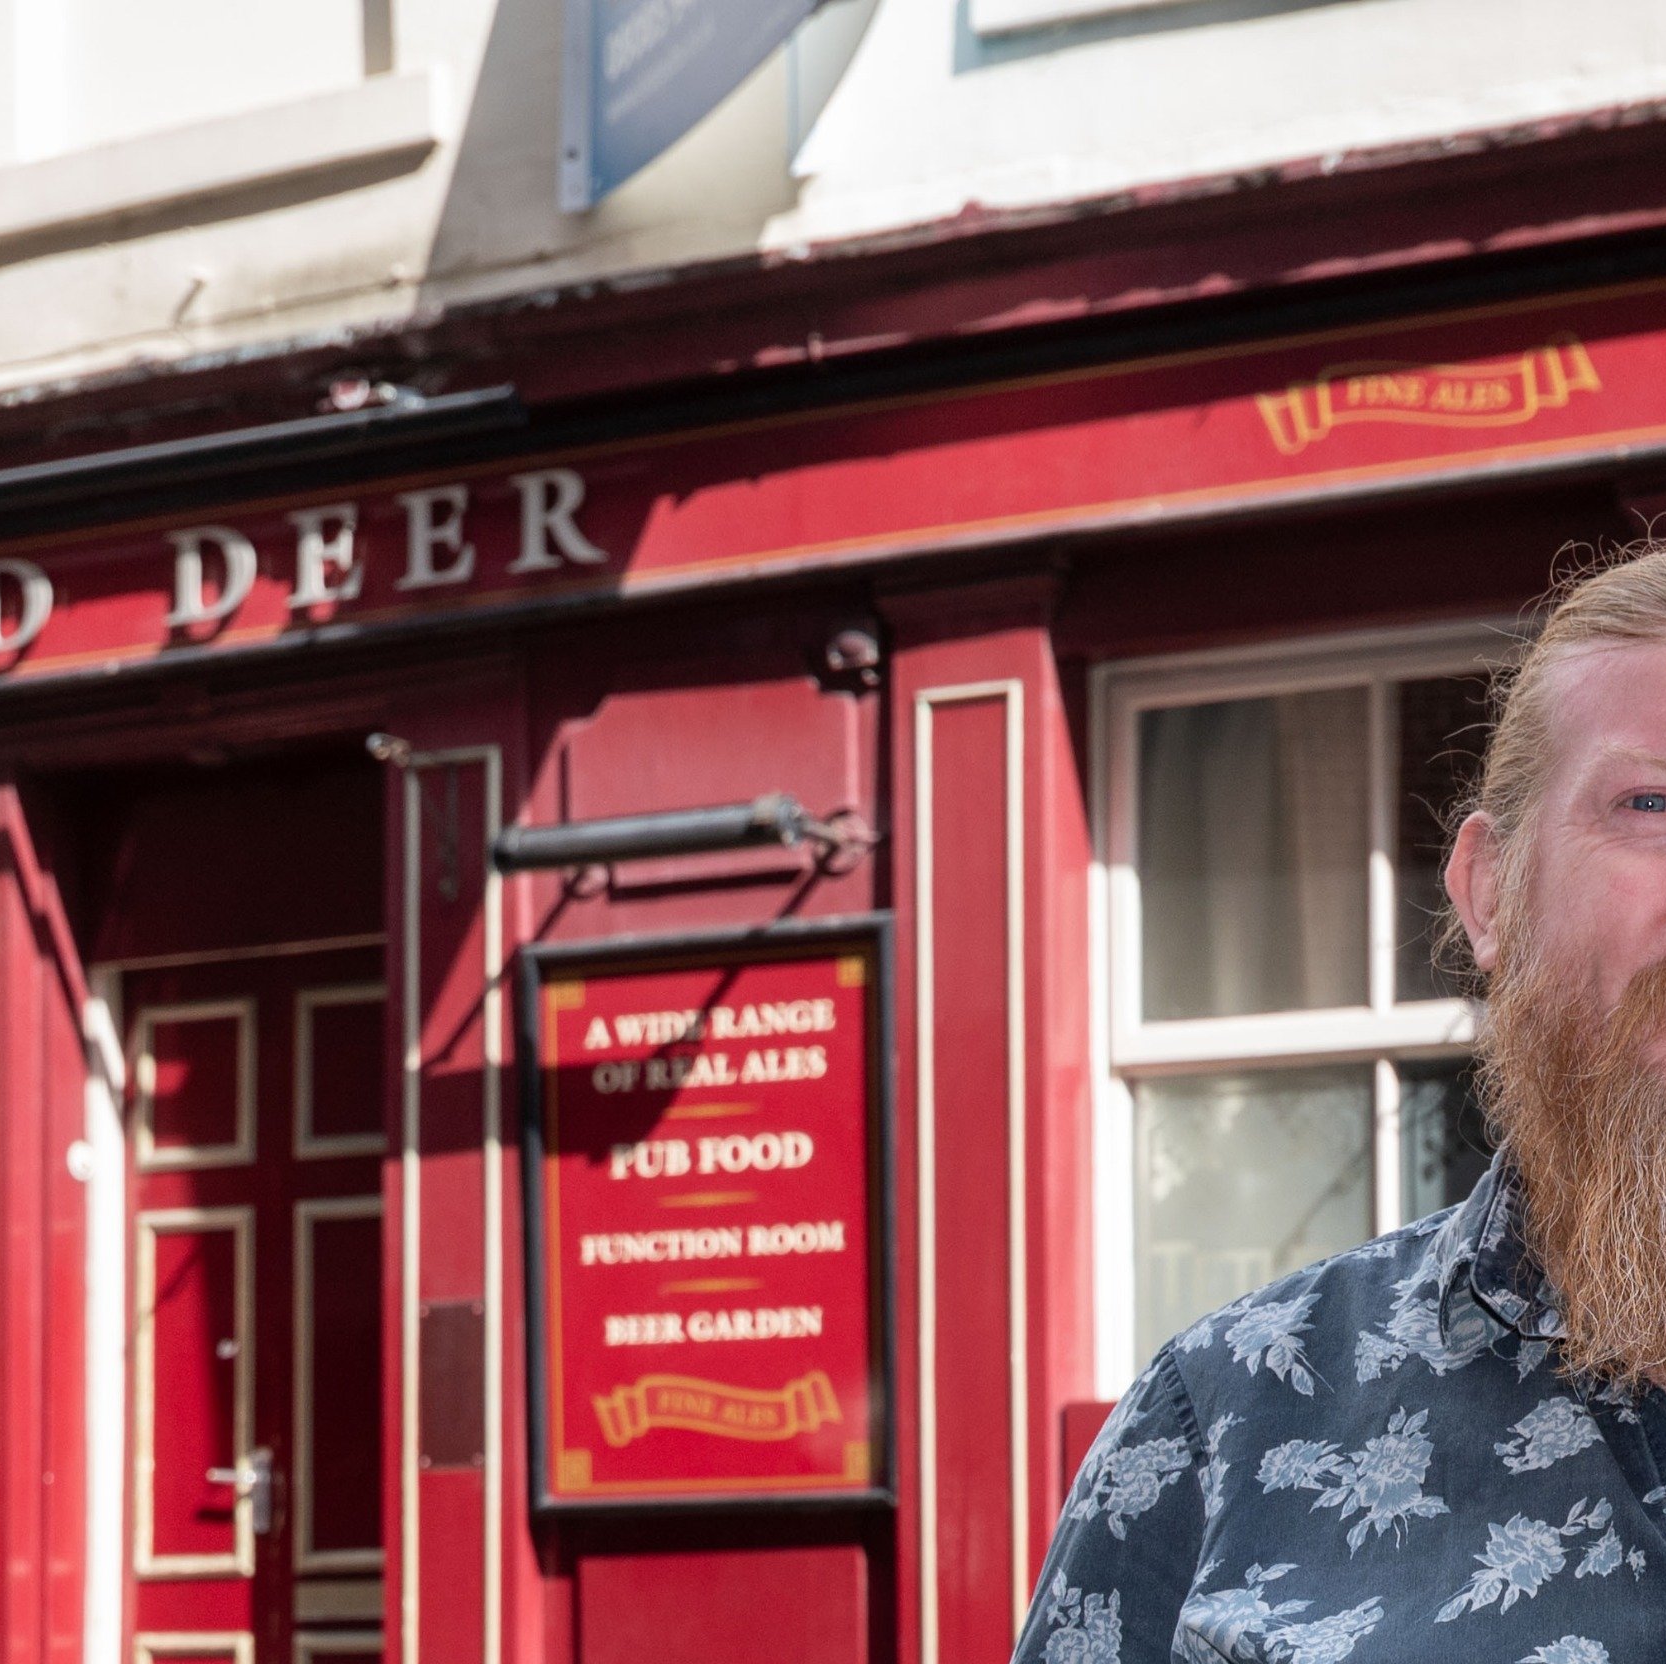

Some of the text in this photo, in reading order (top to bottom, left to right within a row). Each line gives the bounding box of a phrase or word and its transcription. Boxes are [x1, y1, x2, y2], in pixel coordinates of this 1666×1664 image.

[166, 468, 609, 629] DEER
[584, 998, 835, 1050] A WIDE RANGE
[592, 1045, 828, 1094] OF REAL ALES
[609, 1130, 814, 1180] PUB FOOD
[580, 1220, 845, 1266] FUNCTION ROOM
[604, 1304, 824, 1347] BEER GARDEN
